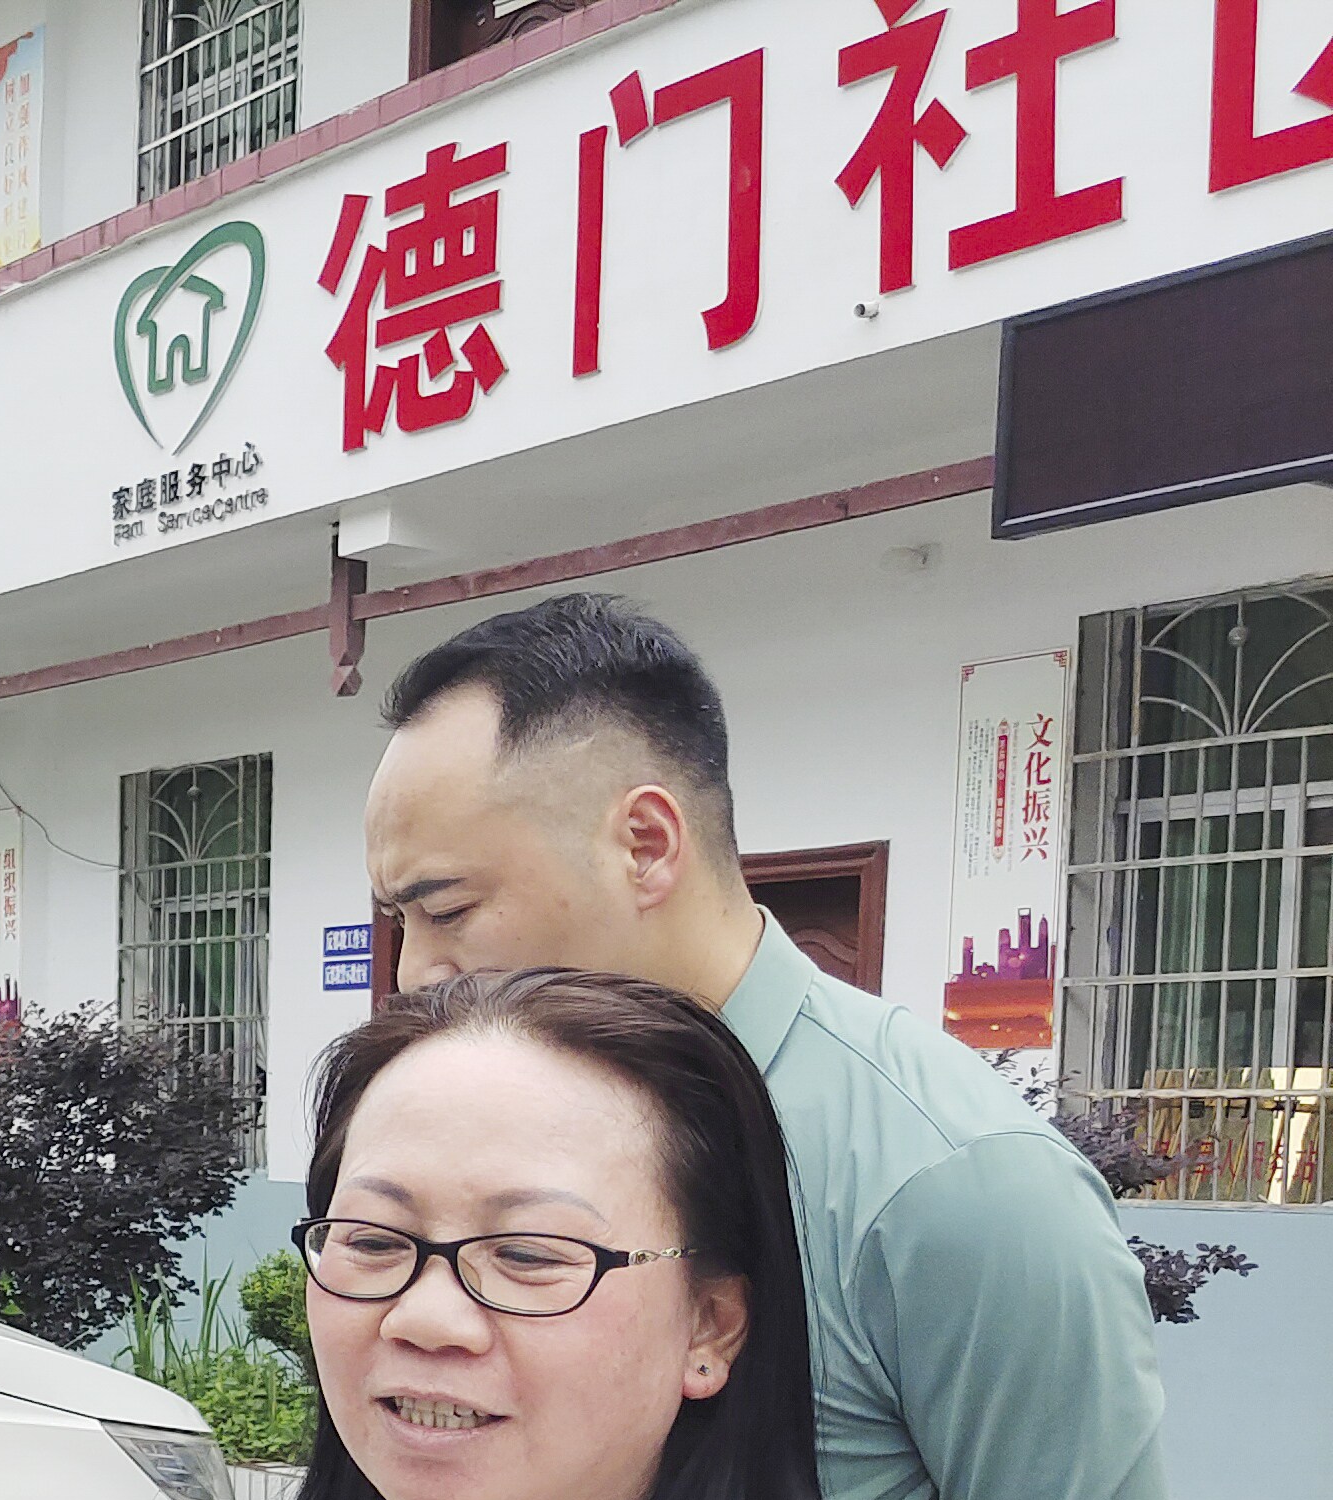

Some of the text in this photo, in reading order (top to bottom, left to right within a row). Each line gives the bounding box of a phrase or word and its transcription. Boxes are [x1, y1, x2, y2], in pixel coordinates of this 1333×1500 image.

[112, 441, 263, 520] 家庭服务中心
[1020, 712, 1053, 863] 文化振兴
